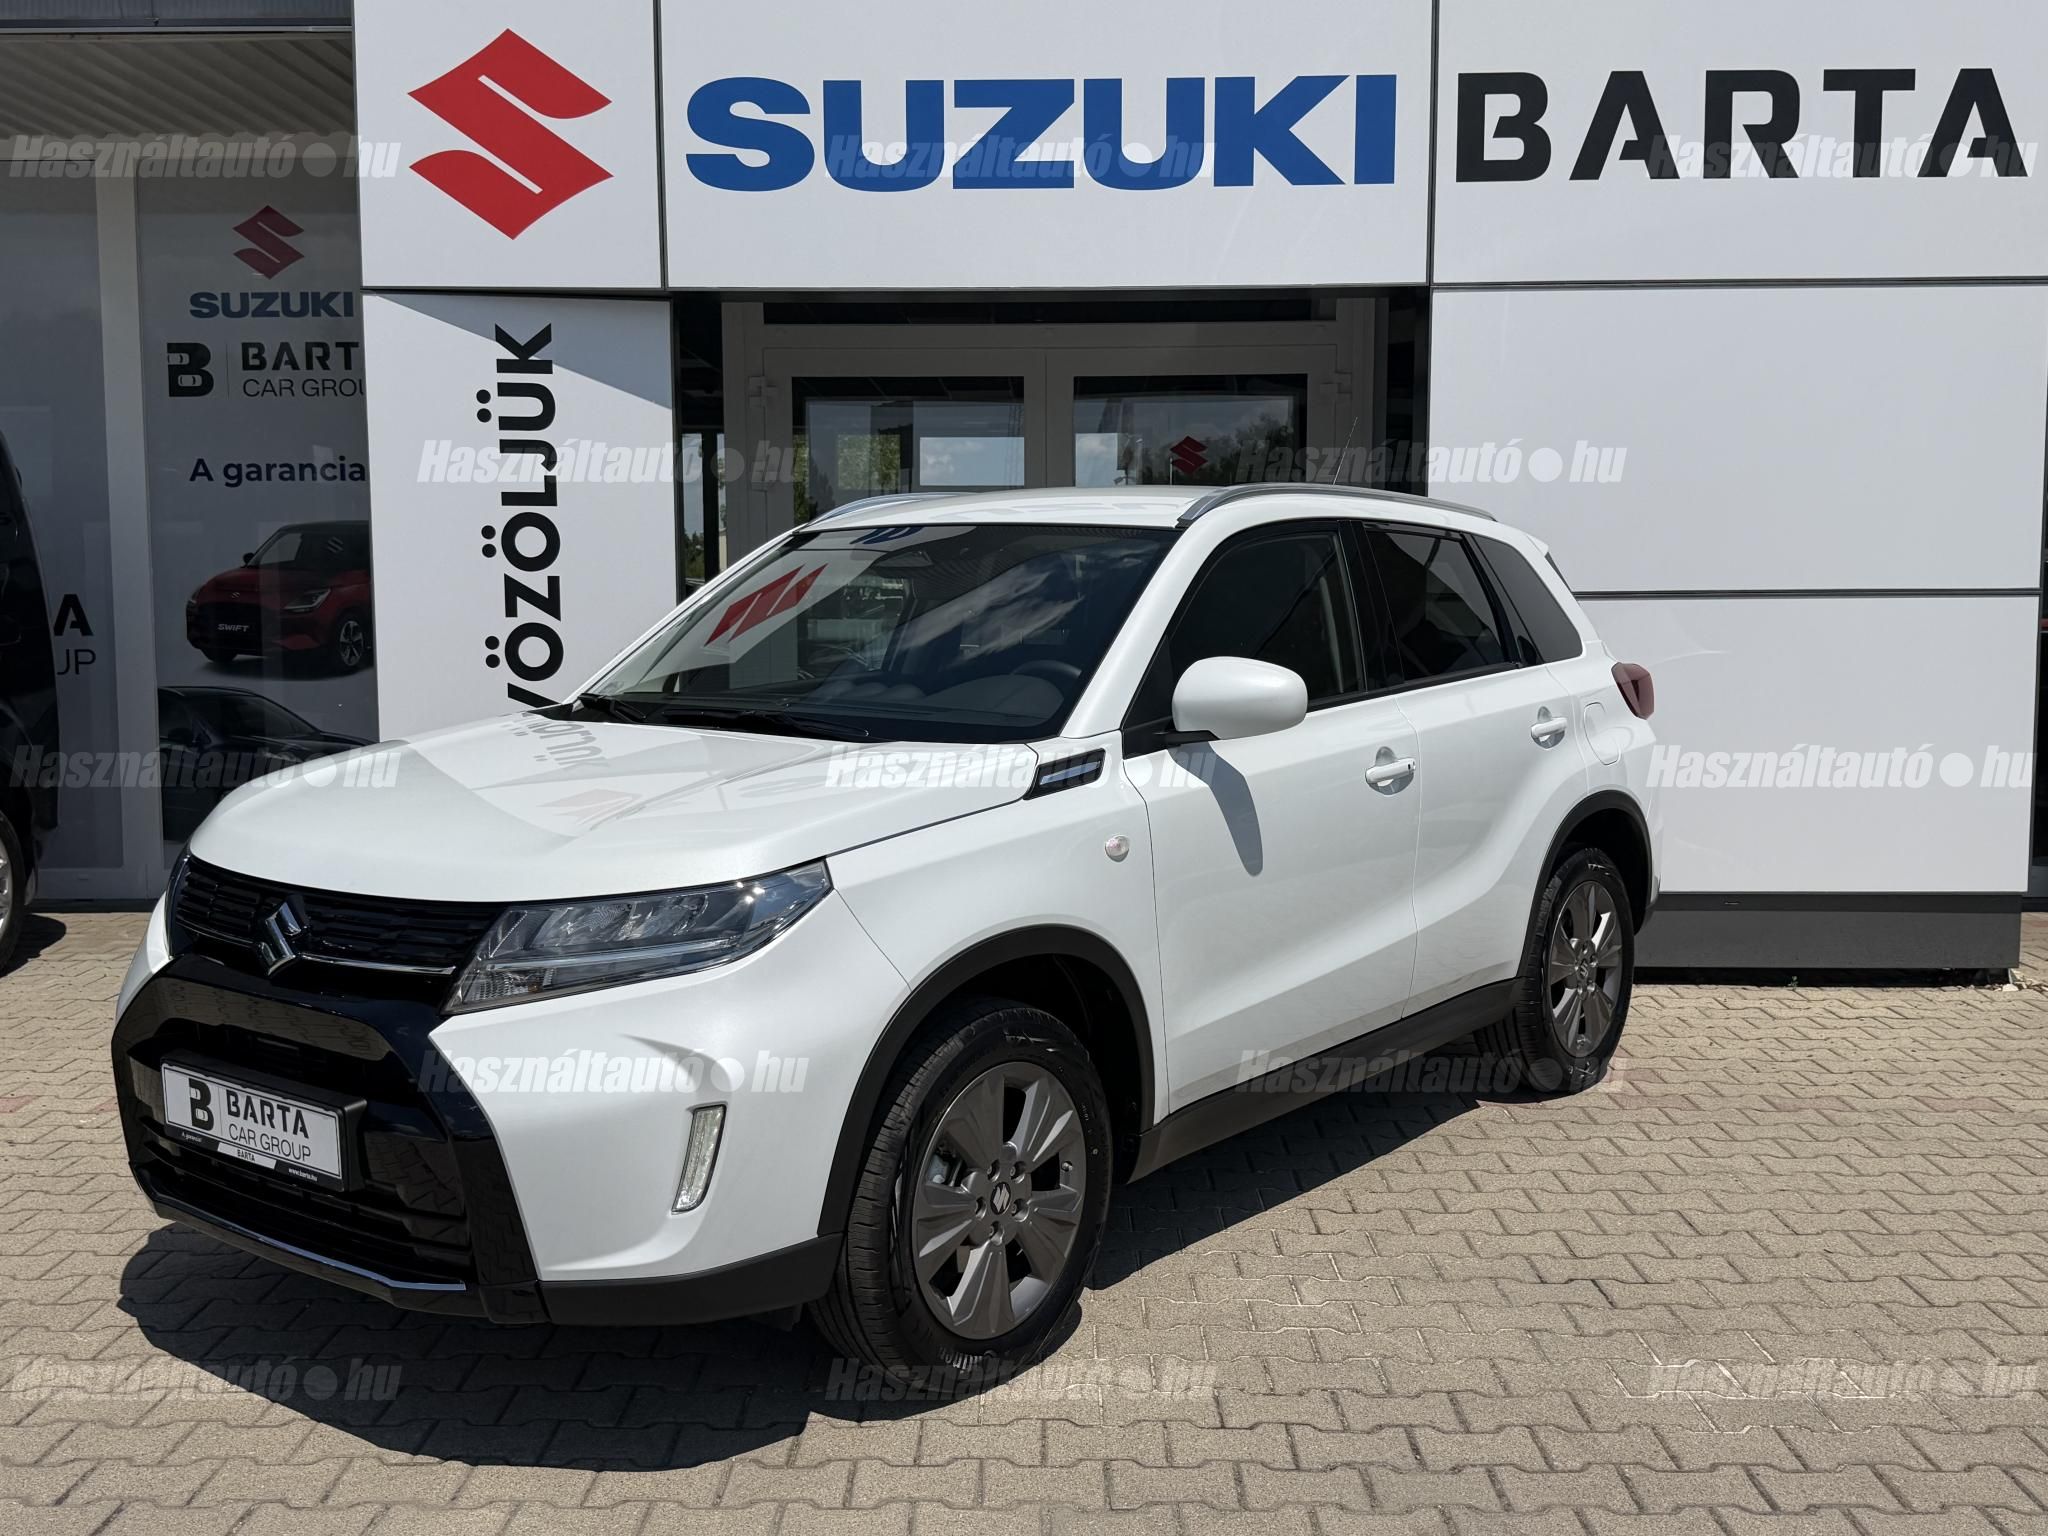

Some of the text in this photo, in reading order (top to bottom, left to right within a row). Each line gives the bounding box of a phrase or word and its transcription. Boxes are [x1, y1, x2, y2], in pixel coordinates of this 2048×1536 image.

[685, 74, 1396, 192] SUZUKI
[1455, 68, 2028, 182] BARTA
[190, 291, 354, 319] SUZUKI
[243, 378, 295, 397] CAR
[189, 455, 366, 488] A garancia
[226, 1089, 309, 1139] BARTA
[228, 1123, 258, 1148] CAR
[260, 1132, 311, 1162] GROUP
